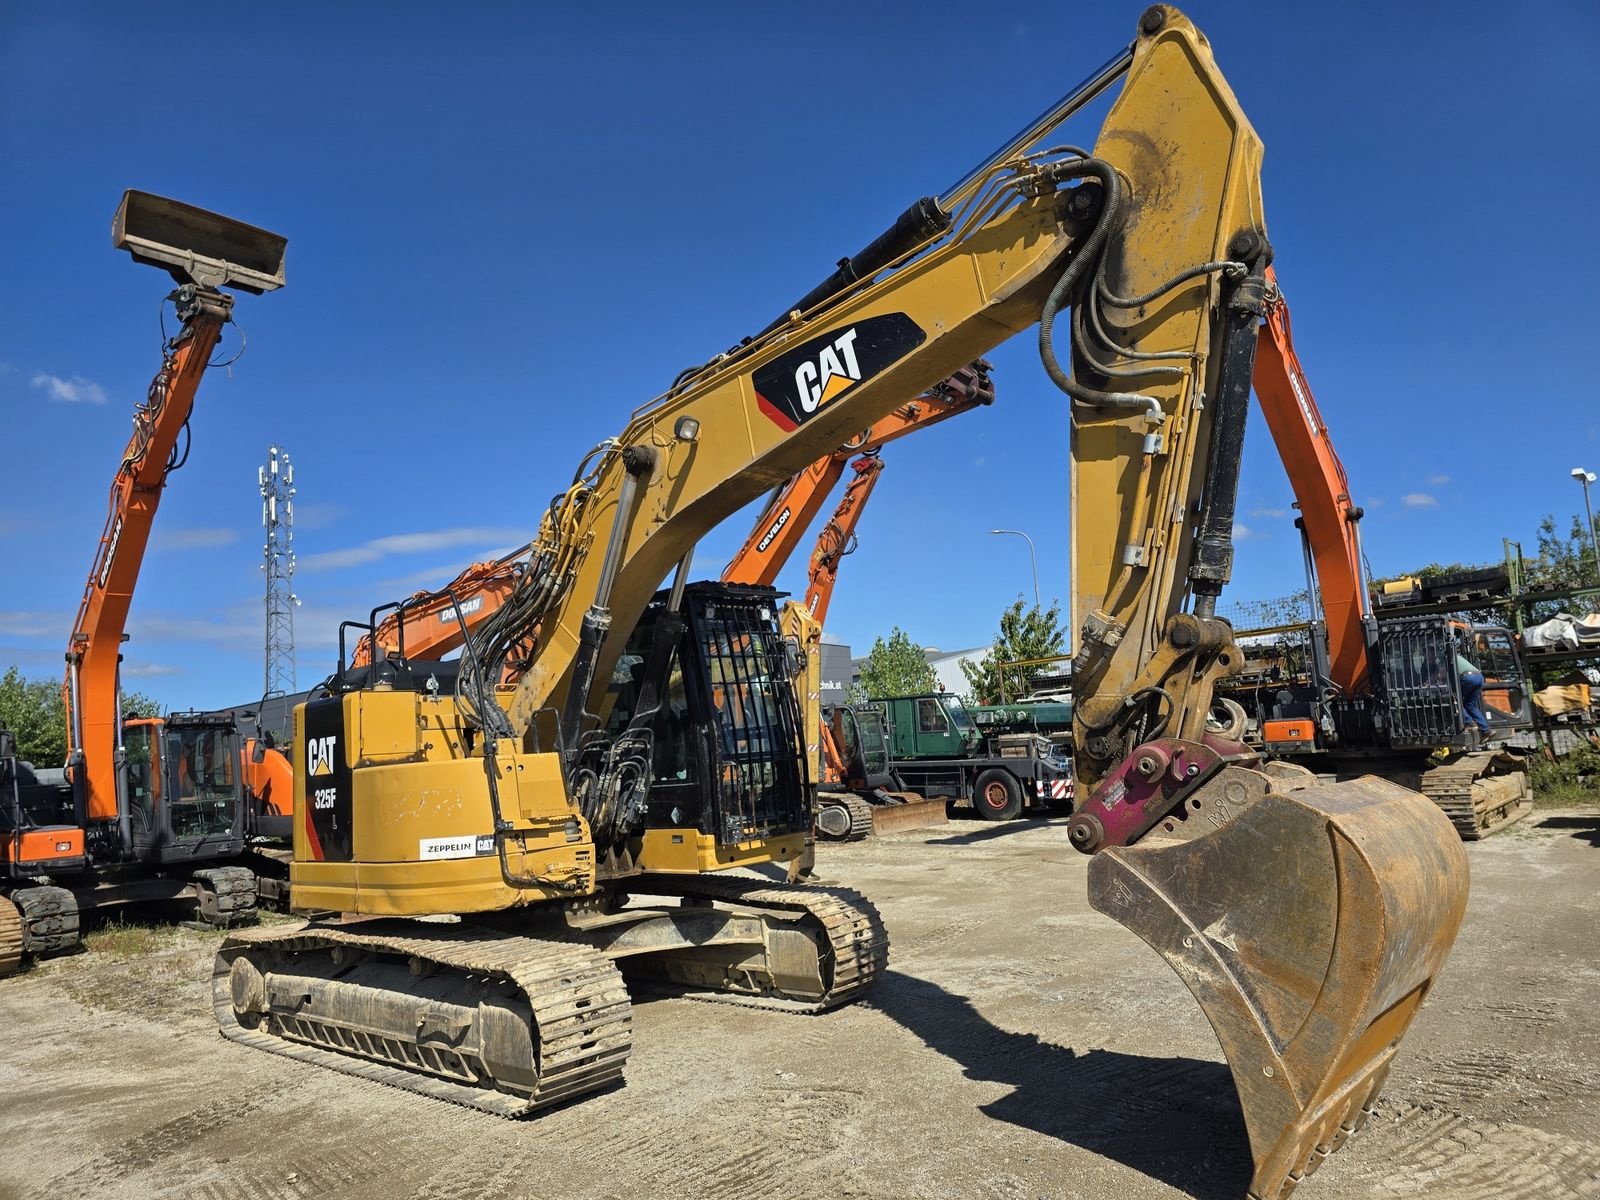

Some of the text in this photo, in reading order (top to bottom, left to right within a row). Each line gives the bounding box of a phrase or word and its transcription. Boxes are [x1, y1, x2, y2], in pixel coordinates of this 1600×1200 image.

[795, 328, 861, 413] CAT
[759, 509, 790, 551] DEVELON
[101, 518, 121, 586] DOOSAN
[308, 736, 336, 776] CAT
[315, 788, 336, 809] 325F
[428, 839, 494, 852] ZEPPELIN CAT
